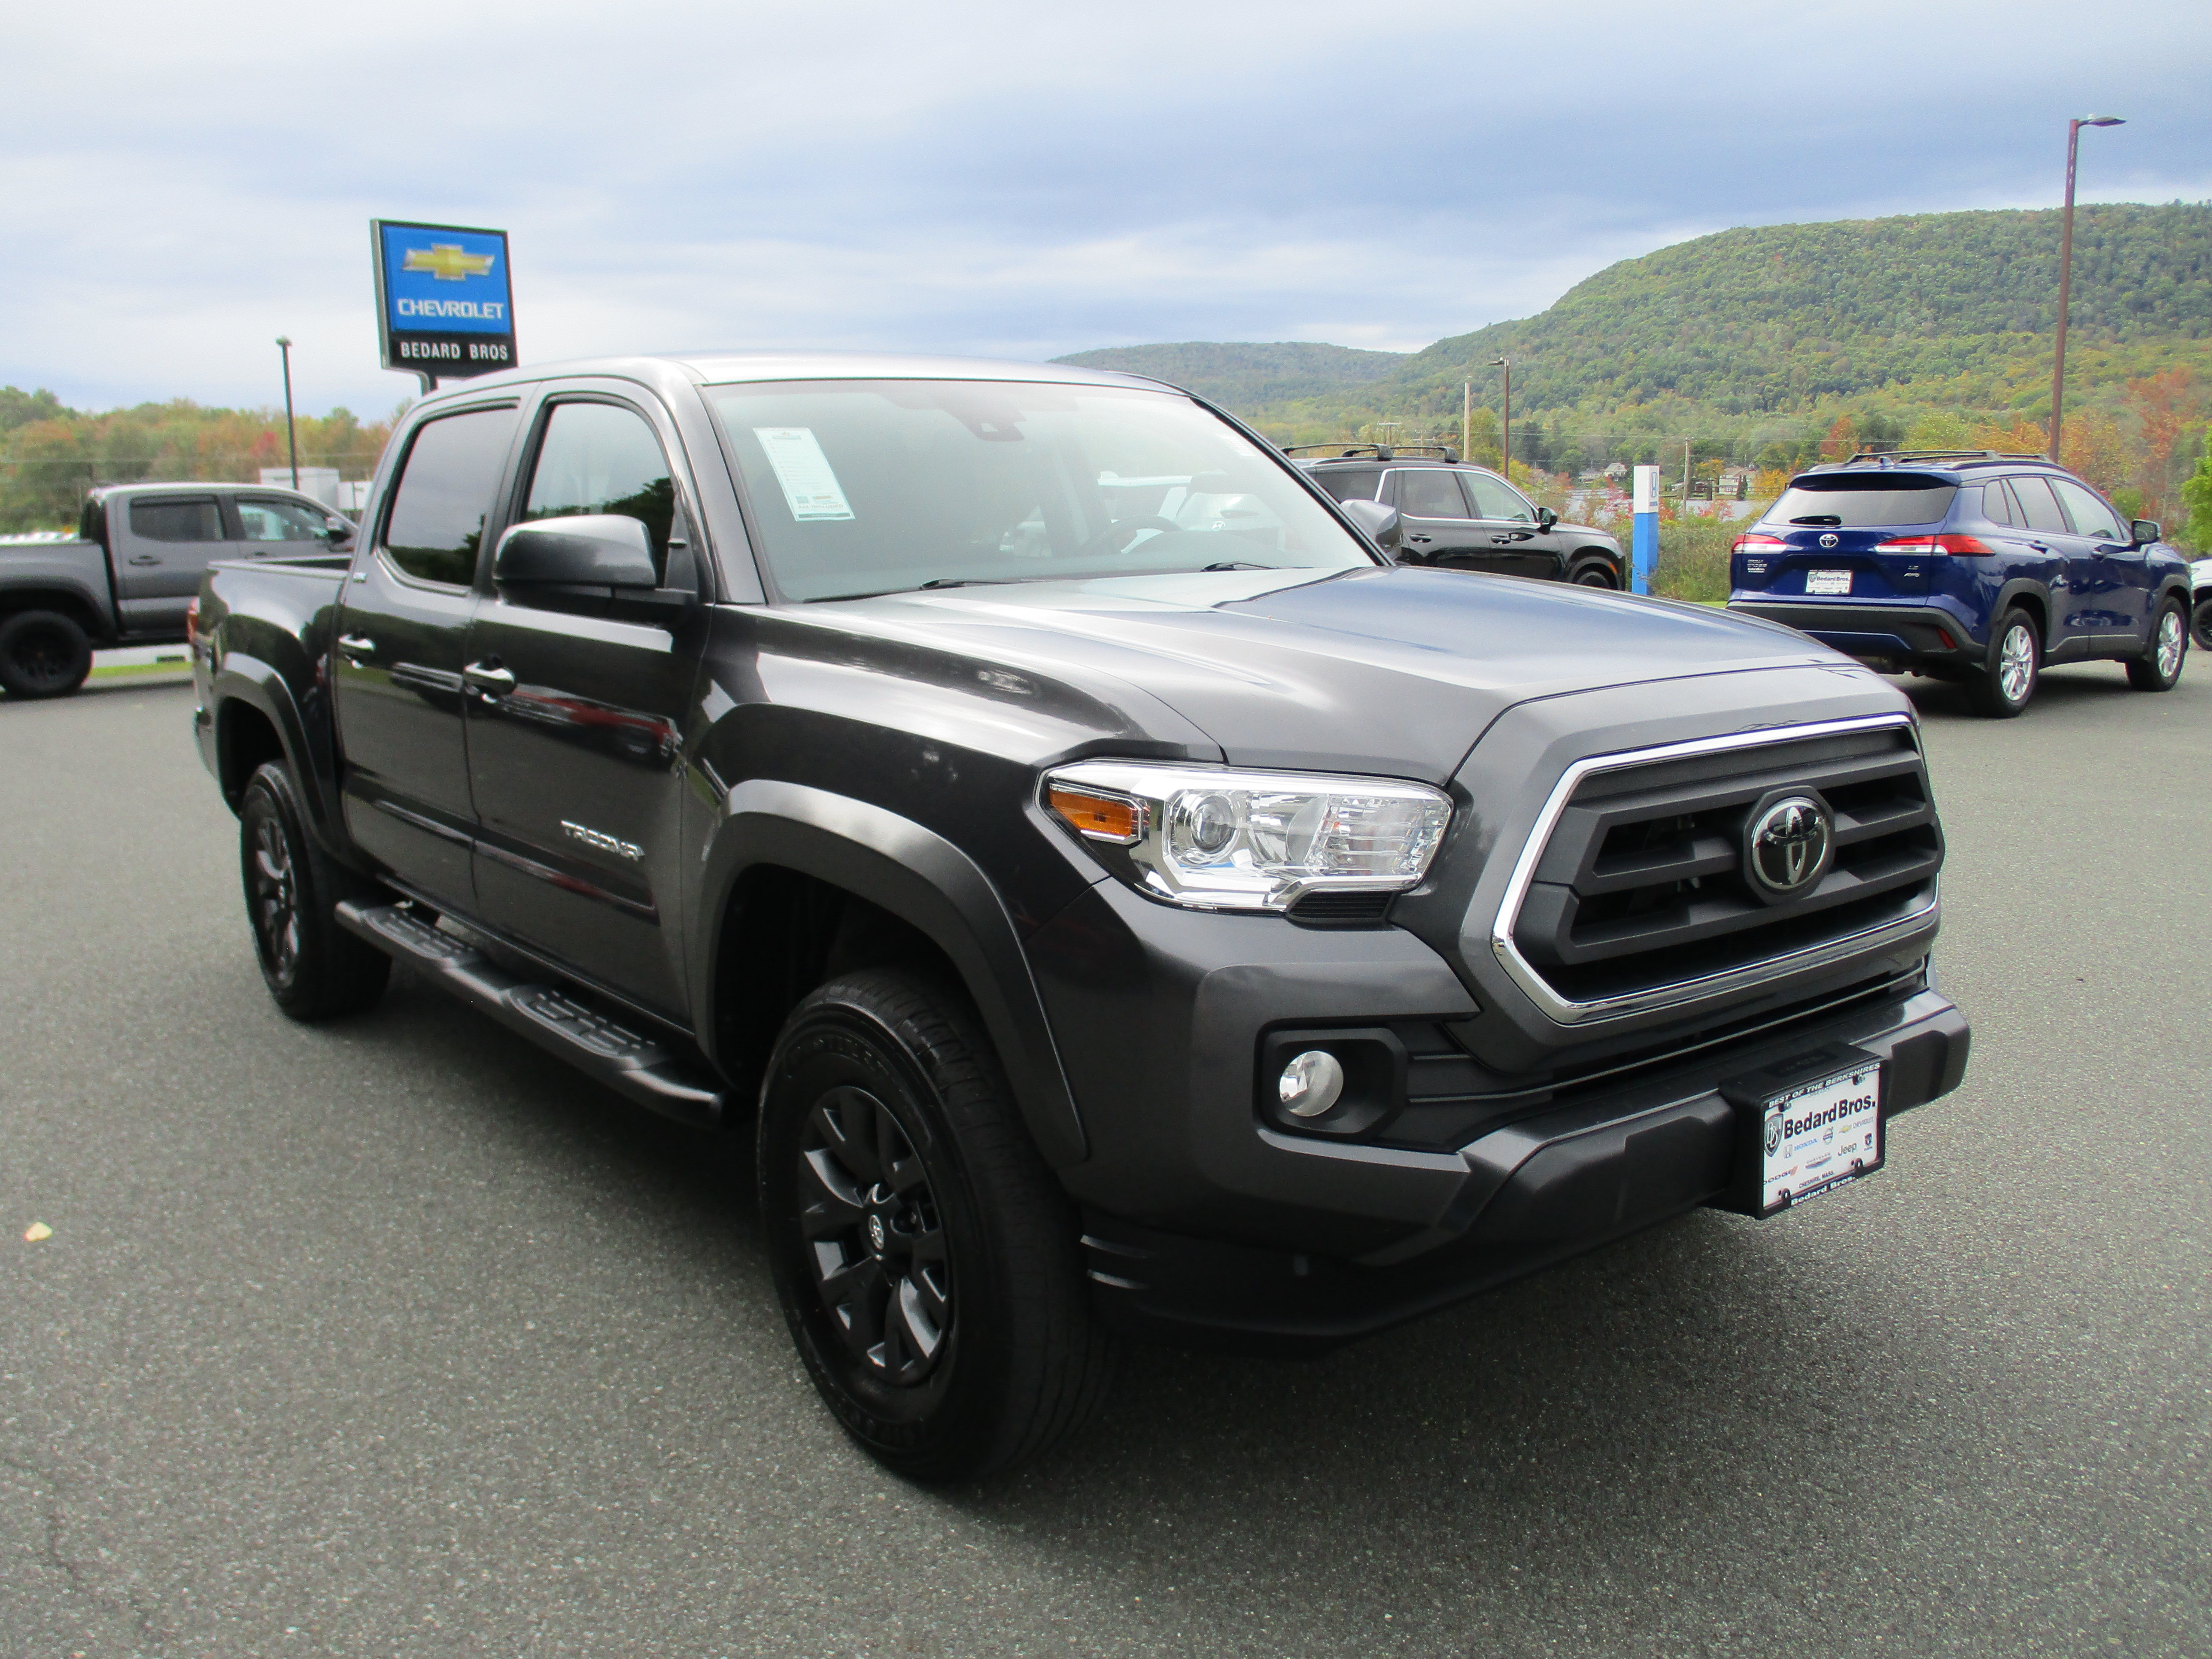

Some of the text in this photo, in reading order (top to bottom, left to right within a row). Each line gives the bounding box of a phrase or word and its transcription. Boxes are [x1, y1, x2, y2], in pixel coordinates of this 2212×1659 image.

[398, 298, 504, 319] CHEVROLET
[401, 342, 508, 360] BEDARD BROS
[1768, 1095, 1791, 1108] BEST
[1792, 1089, 1805, 1098] OF
[1806, 1082, 1823, 1093] THE
[1825, 1062, 1881, 1086] BERKSHIRES
[1784, 1095, 1876, 1139] Bedard Bros.
[1794, 1138, 1818, 1151] HONDA
[1838, 1143, 1857, 1156] Jeep
[1791, 1186, 1828, 1206] Bedard
